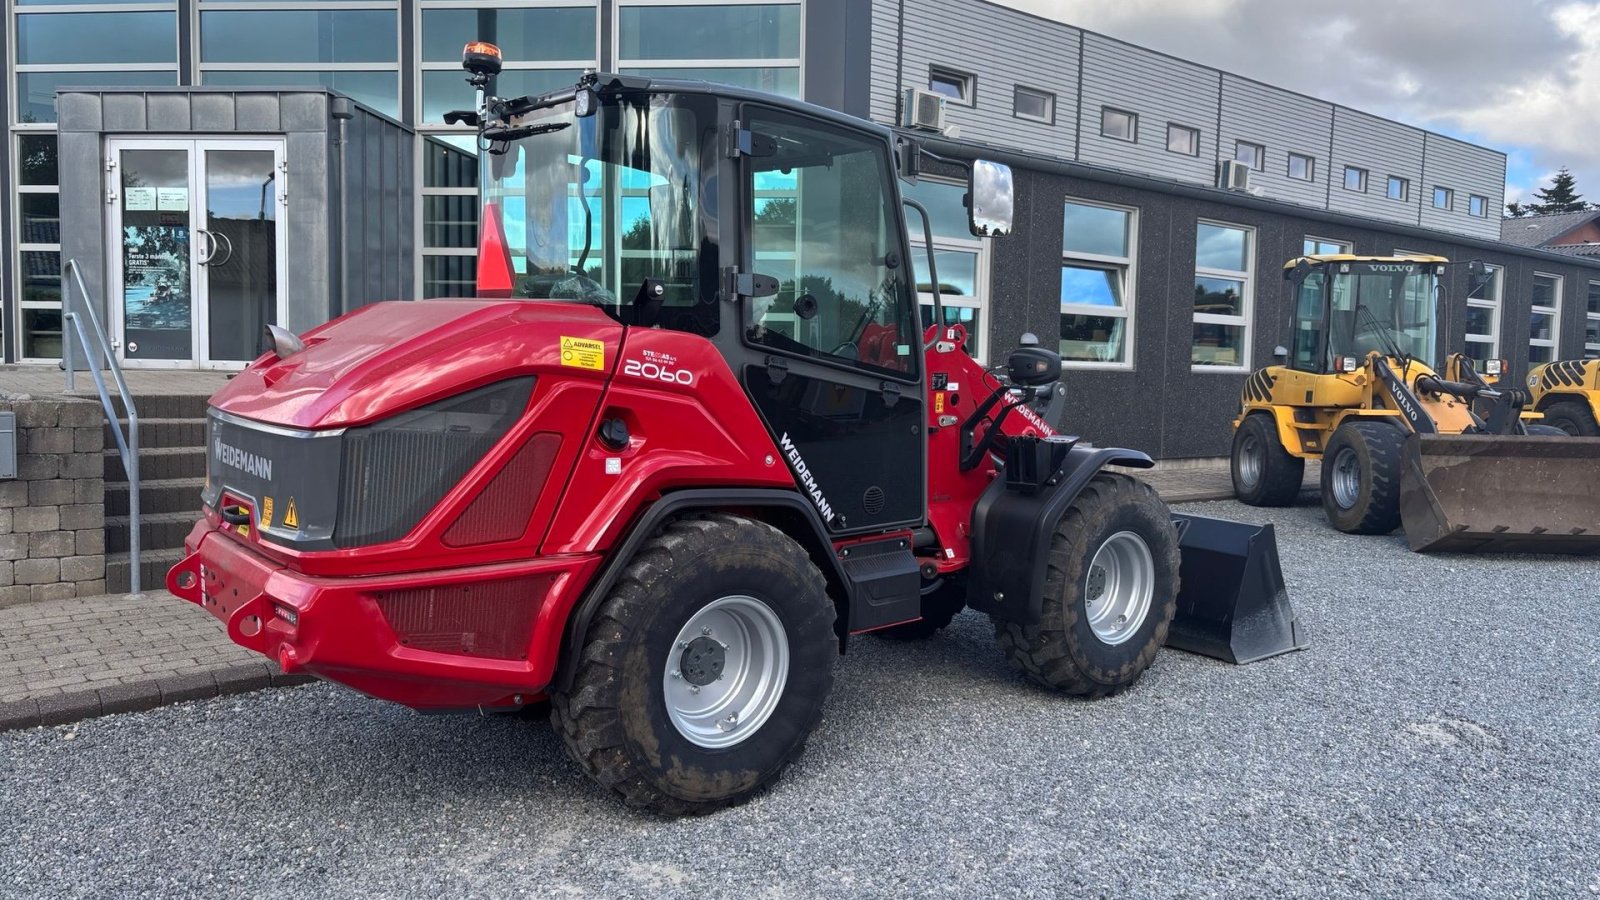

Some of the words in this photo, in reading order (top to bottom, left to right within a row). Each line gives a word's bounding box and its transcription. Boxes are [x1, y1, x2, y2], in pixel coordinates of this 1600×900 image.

[1370, 264, 1414, 272] VOLVO
[574, 341, 602, 349] ADVARSEL
[625, 359, 693, 385] 2060
[1392, 381, 1418, 422] VOLVO
[214, 437, 272, 481] WEIDEMANN
[781, 431, 835, 523] WEIDEMANN
